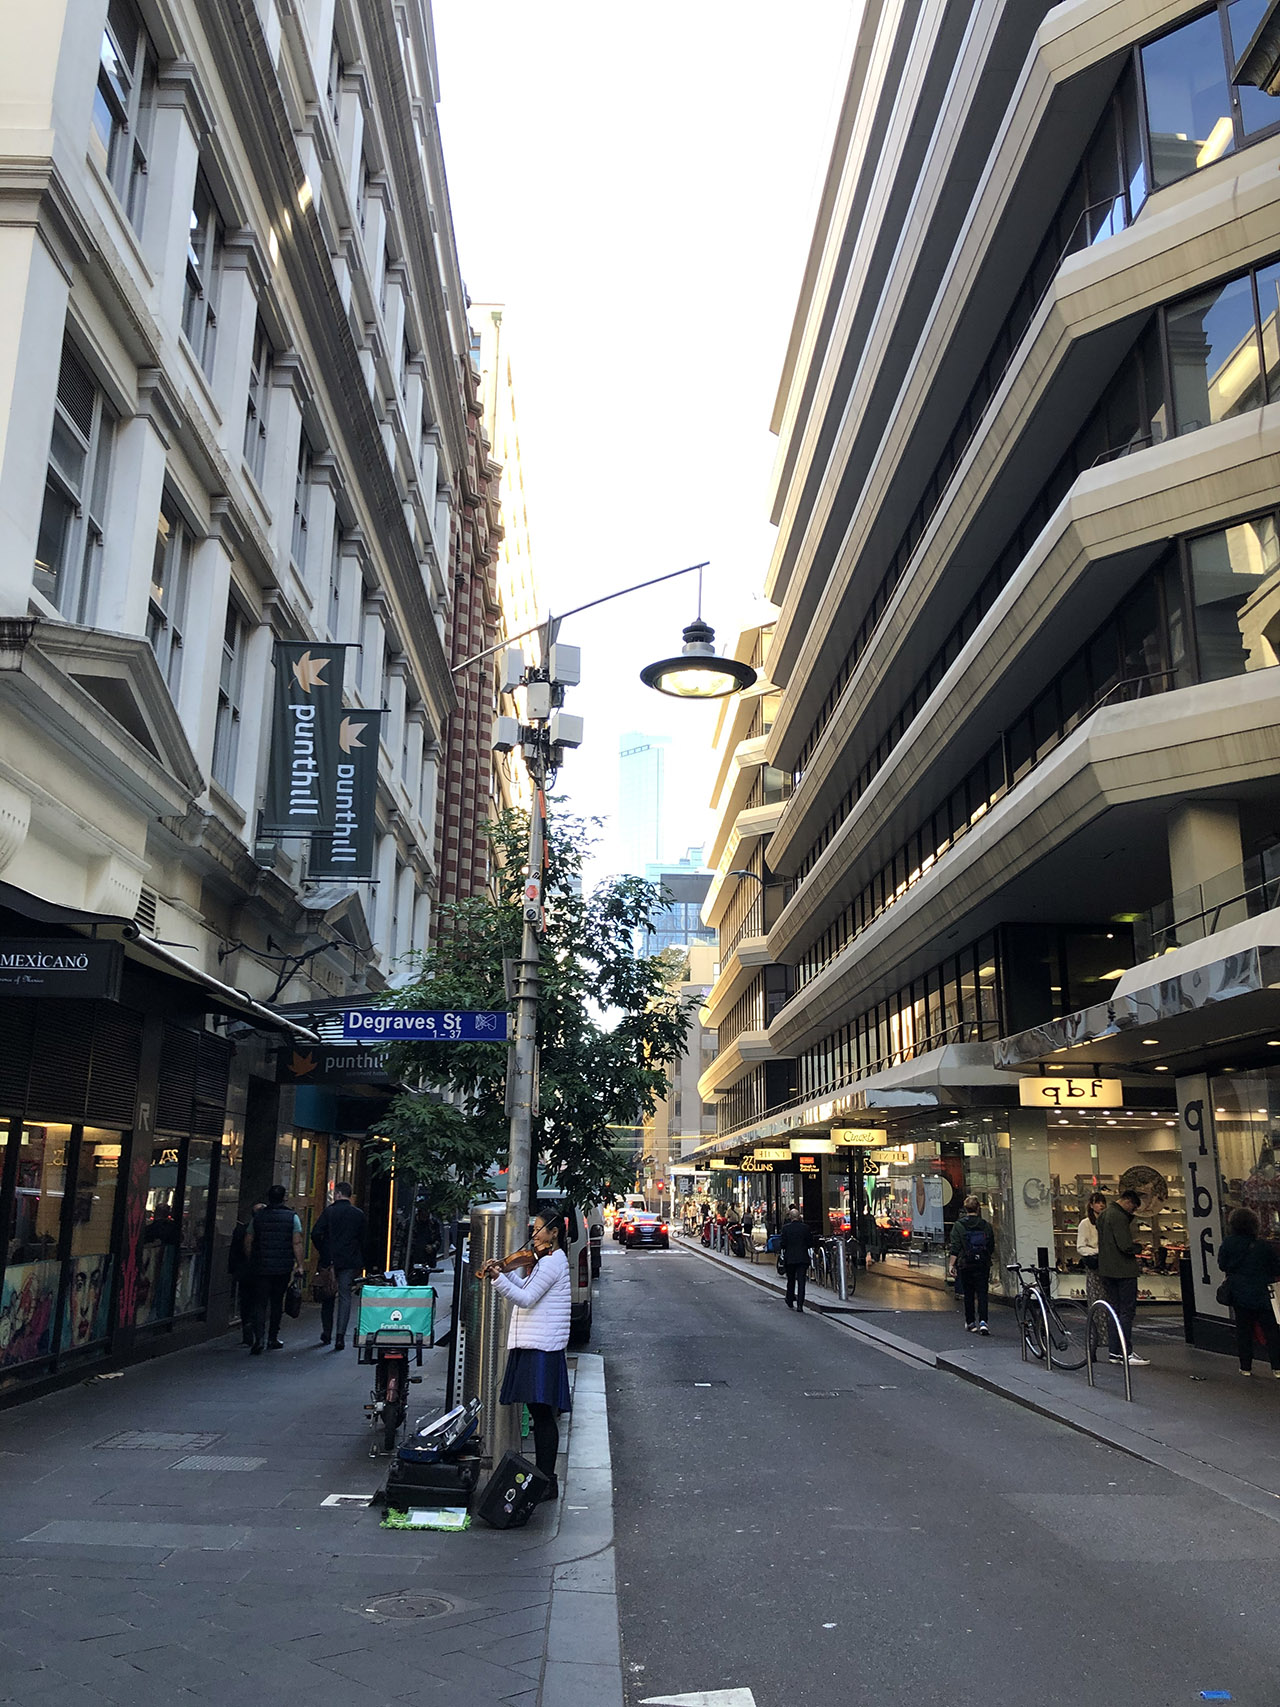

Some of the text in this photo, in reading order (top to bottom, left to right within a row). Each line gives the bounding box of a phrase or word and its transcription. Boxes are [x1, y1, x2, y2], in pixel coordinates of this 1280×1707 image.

[288, 704, 320, 815] punthill
[349, 1012, 462, 1033] Degraves St
[1041, 1079, 1103, 1105] qbf
[741, 1163, 774, 1172] COLLINS
